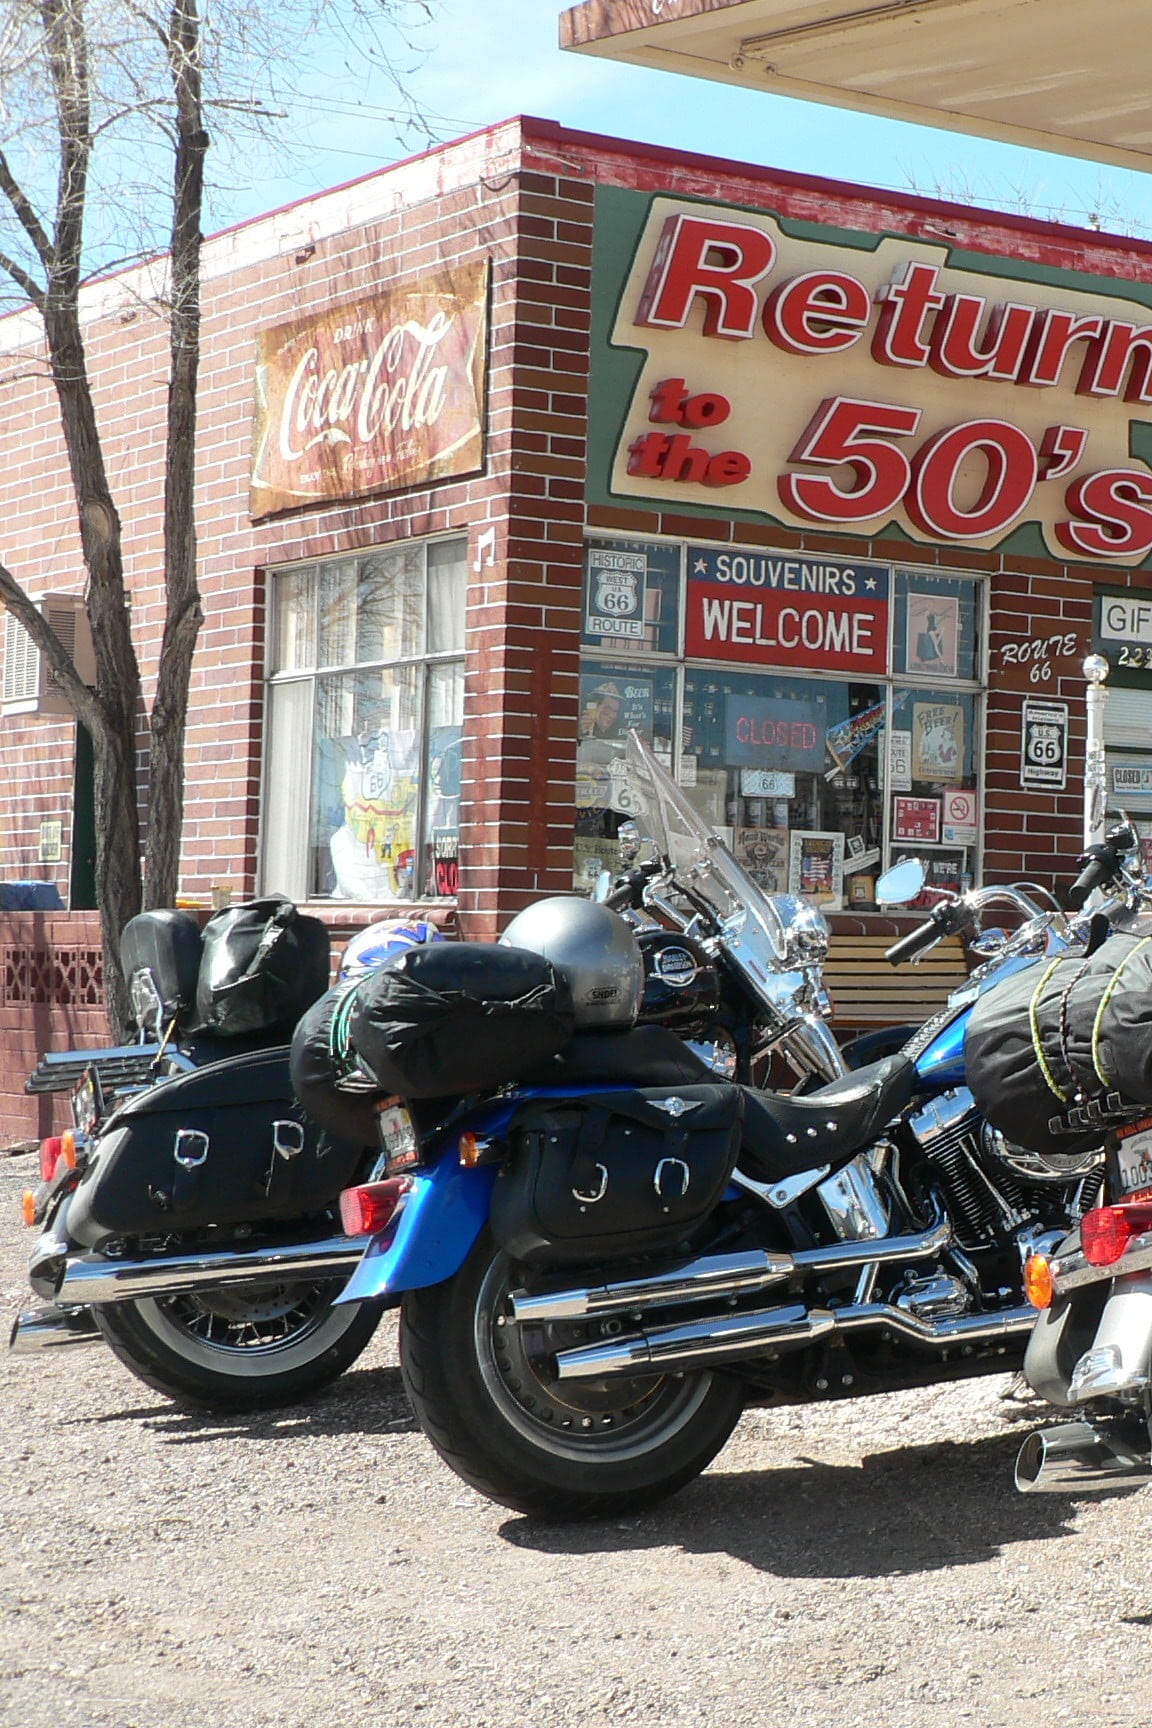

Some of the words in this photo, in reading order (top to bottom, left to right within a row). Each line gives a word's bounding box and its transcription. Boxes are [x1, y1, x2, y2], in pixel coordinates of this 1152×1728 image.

[334, 317, 375, 344] DRINK
[648, 378, 731, 428] to
[627, 430, 751, 487] the
[591, 553, 644, 571] HISTORIC
[605, 575, 628, 585] WEST
[716, 555, 857, 596] SOUVENIRS
[603, 593, 630, 611] 66
[591, 617, 639, 634] ROUTE
[702, 597, 876, 656] WELCOME
[1000, 633, 1078, 666] ROUTE
[1029, 661, 1052, 683] 66
[736, 716, 818, 750] CLOSED
[1033, 740, 1056, 760] 66
[1027, 767, 1059, 777] Highway
[1114, 769, 1140, 784] CLOSED
[369, 774, 384, 794] 66
[761, 778, 775, 791] 66
